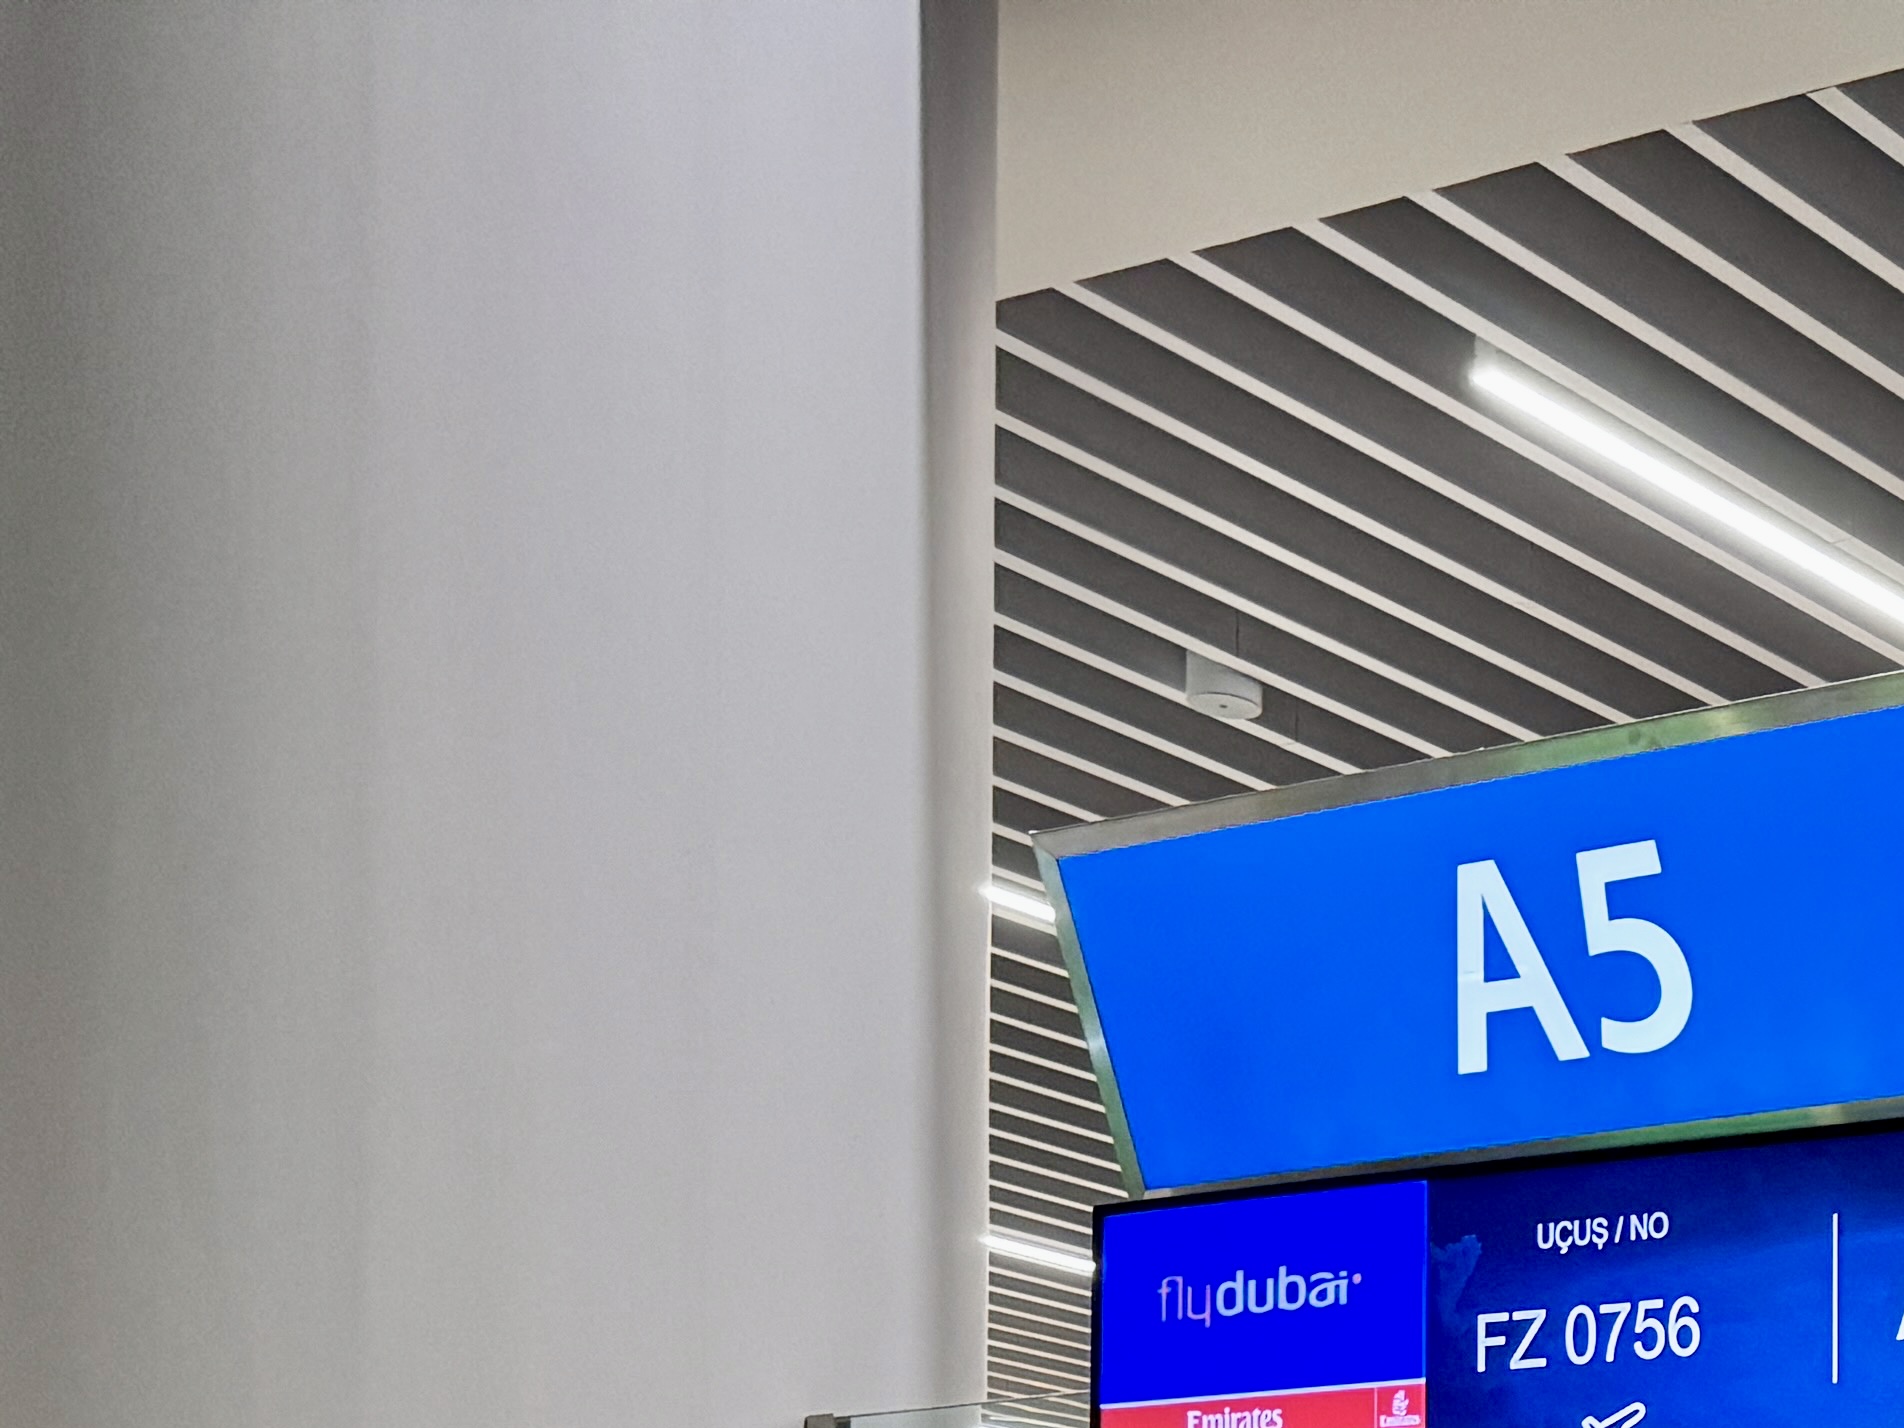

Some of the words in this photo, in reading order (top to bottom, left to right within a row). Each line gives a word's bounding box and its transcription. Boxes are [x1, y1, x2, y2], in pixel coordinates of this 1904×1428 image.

[1457, 839, 1693, 1075] A5
[1536, 1217, 1609, 1256] UÇUŞ
[1629, 1211, 1670, 1241] NO
[1157, 1267, 1362, 1329] flydubai
[1475, 1308, 1547, 1374] FZ
[1565, 1295, 1701, 1365] 0756
